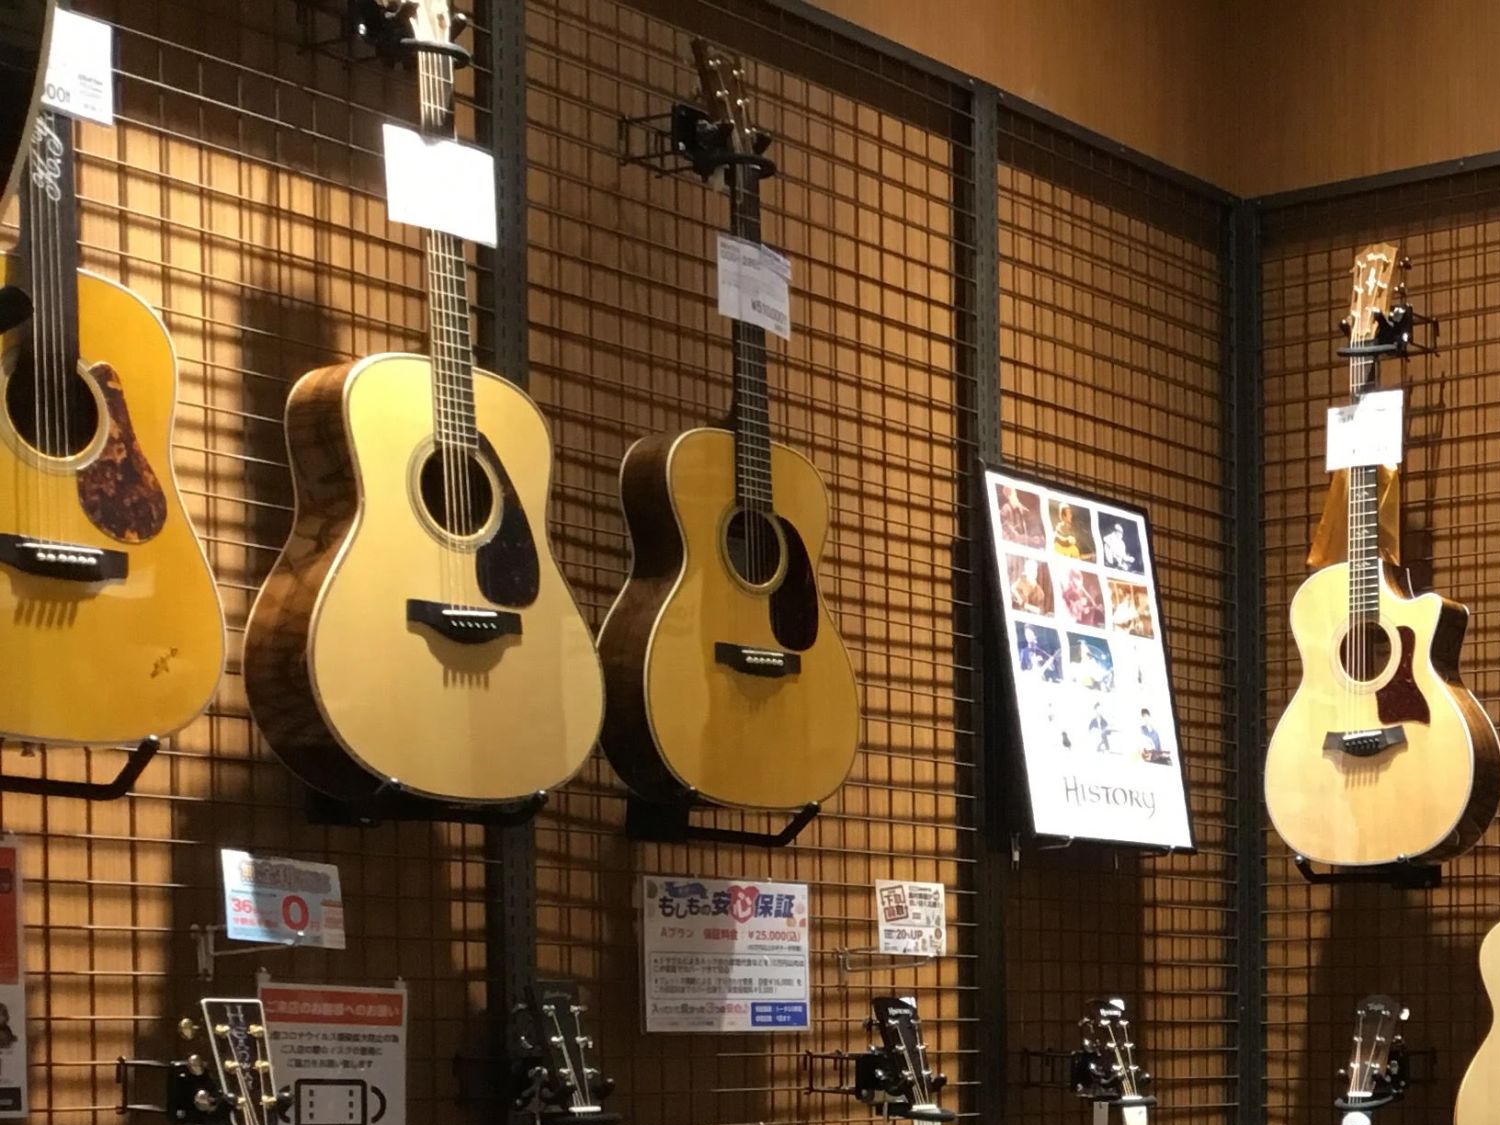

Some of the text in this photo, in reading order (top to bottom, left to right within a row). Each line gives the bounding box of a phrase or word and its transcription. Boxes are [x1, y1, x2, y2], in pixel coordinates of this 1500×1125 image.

[1063, 774, 1156, 819] HISTORY
[659, 886, 796, 922] もしもの安心保証
